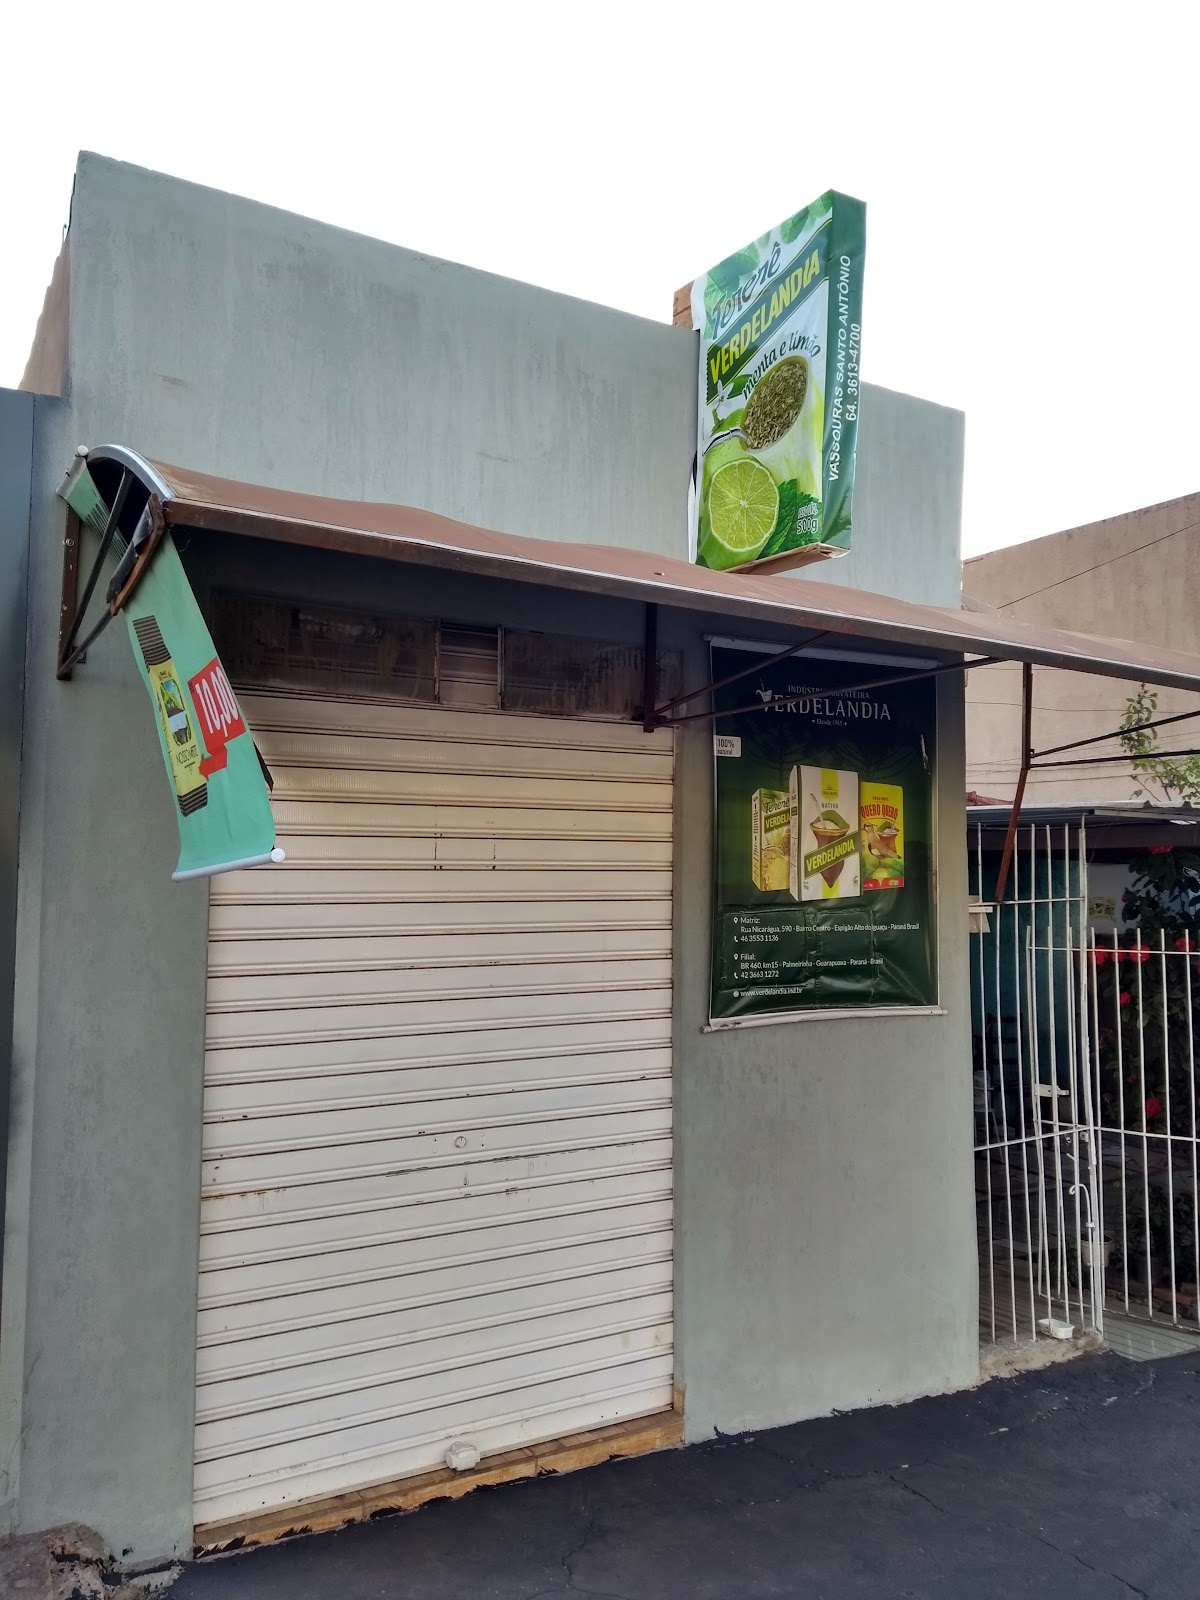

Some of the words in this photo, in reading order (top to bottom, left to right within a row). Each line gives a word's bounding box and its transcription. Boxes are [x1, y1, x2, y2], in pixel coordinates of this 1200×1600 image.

[836, 255, 851, 326] ANTÔNIO
[710, 248, 820, 385] VERDELANDIA
[836, 328, 847, 383] SANTO
[847, 323, 861, 396] 3613-4700
[742, 348, 778, 400] menta
[779, 341, 787, 357] e
[845, 401, 857, 421] 64.
[829, 386, 844, 481] VASSOURAS
[796, 517, 818, 534] 500g
[194, 666, 239, 738] 10,00
[717, 738, 735, 748] 100%
[861, 804, 880, 819] QUERO
[881, 804, 899, 820] QUERO
[806, 839, 855, 872] VERDELANDIA
[834, 924, 853, 932] Espigão
[740, 953, 756, 961] Filial:
[763, 961, 778, 969] km15
[783, 960, 812, 968] Palmeirinha
[816, 958, 846, 967] Guarapuava
[850, 958, 867, 966] Paraná
[765, 970, 779, 978] 1272
